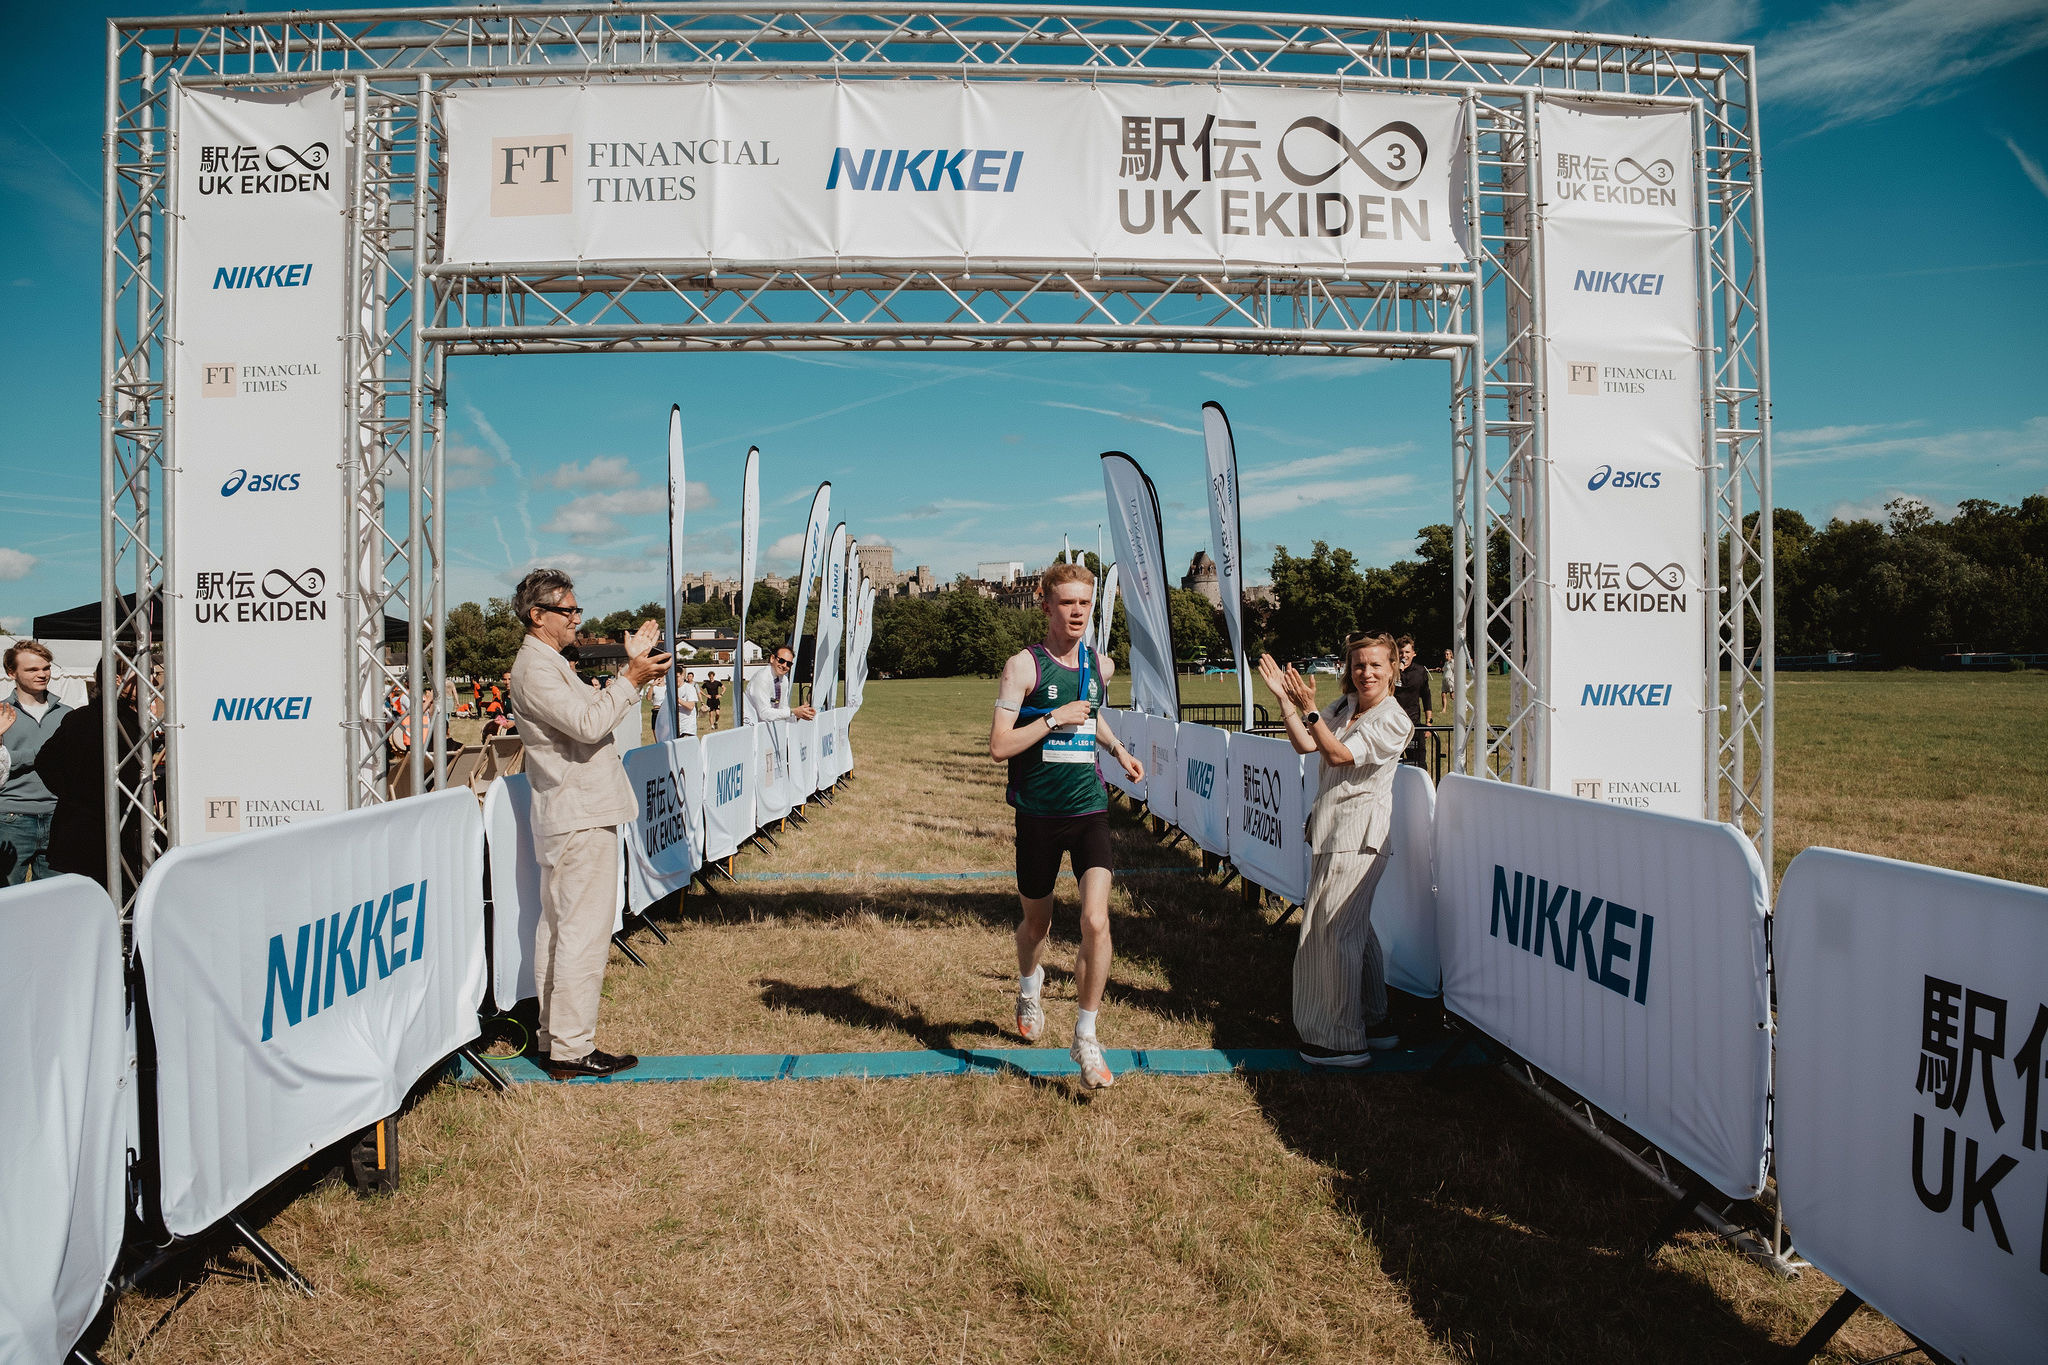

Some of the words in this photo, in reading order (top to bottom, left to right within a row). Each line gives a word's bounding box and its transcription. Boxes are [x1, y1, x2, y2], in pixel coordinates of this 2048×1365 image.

[199, 145, 261, 174] 駅伝
[312, 150, 321, 163] 3
[588, 140, 780, 169] FINANCIAL
[1119, 114, 1262, 183] 駅伝
[1386, 143, 1406, 169] 3
[500, 144, 568, 186] FT
[825, 147, 1024, 193] NIKKEI
[1556, 152, 1609, 183] 駅伝
[1657, 167, 1667, 179] 3
[198, 174, 234, 196] UK
[240, 171, 331, 195] EKIDEN
[588, 175, 697, 203] TIMES
[1556, 180, 1586, 201] UK
[1593, 183, 1678, 207] EKIDEN
[1119, 188, 1201, 235] UK
[1221, 190, 1432, 242] EKIDEN
[212, 263, 313, 290] NIKKEI
[1573, 269, 1665, 296] NIKKEI
[204, 366, 235, 385] FT
[242, 363, 321, 379] FINANCIAL
[1570, 365, 1597, 383] FT
[1603, 366, 1677, 381] FINANCIAL
[243, 379, 288, 393] TIMES
[1603, 381, 1646, 394] TIMES
[195, 570, 256, 601] 駅伝
[307, 576, 317, 590] 3
[1566, 562, 1621, 591] 駅伝
[1669, 571, 1678, 584] 3
[195, 603, 230, 624] UK
[236, 600, 327, 623] EKIDEN
[1566, 592, 1598, 613] UK
[1603, 592, 1688, 613] EKIDEN
[1580, 683, 1673, 707] NIKKEI
[211, 696, 313, 722] NIKKEI
[716, 762, 744, 808] NIKKEI
[1186, 757, 1215, 800] NIKKEI
[1575, 782, 1601, 799] FT
[1608, 781, 1681, 794] FINANCIAL
[208, 800, 238, 819] FT
[245, 799, 324, 812] FINANCIAL
[646, 824, 660, 859] UK
[660, 811, 688, 851] EKIDEN
[1251, 811, 1282, 850] EKIDEN
[1490, 864, 1654, 1006] NIKKEI
[260, 878, 428, 1043] NIKKEI
[1911, 1112, 2020, 1256] UK
